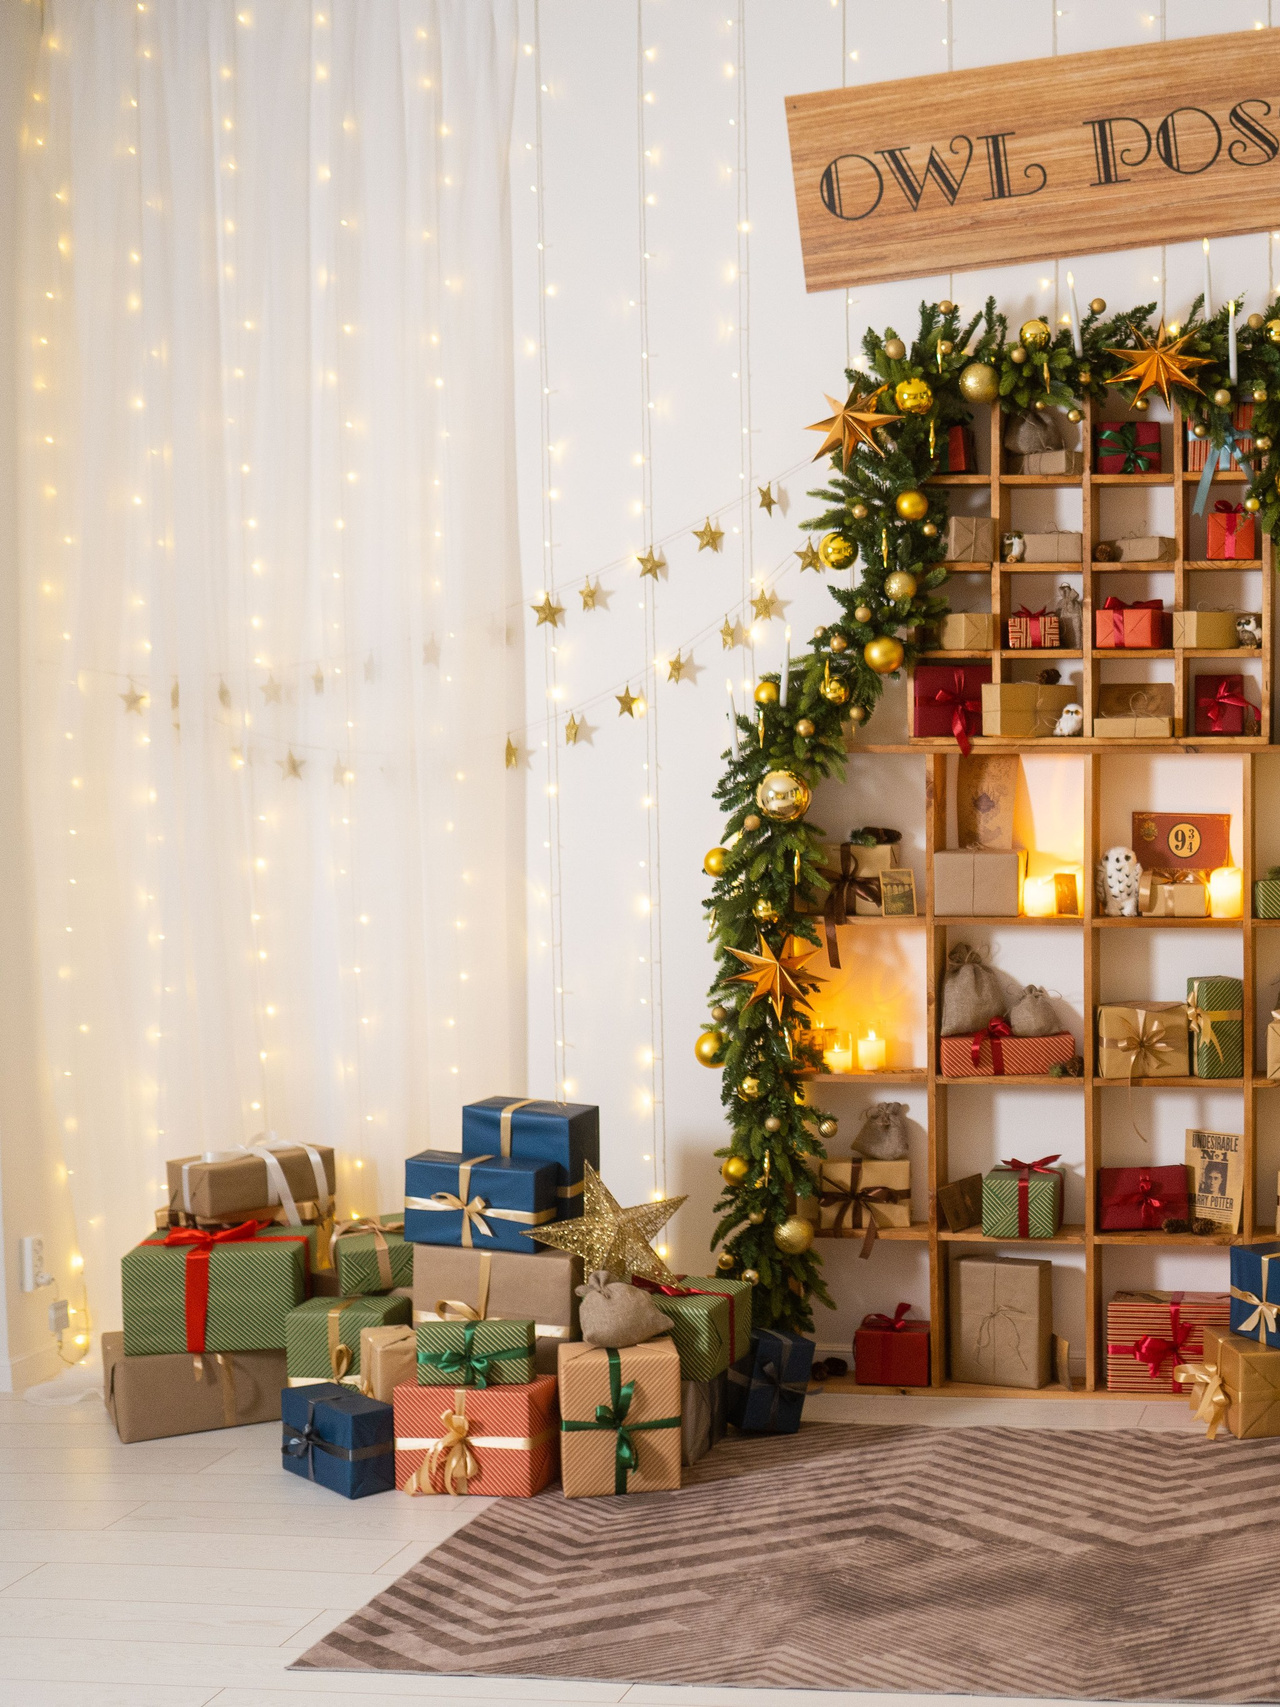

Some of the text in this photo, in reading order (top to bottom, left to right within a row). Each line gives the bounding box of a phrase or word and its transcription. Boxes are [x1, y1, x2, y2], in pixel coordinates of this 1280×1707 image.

[820, 132, 1047, 221] OWL
[1192, 1134, 1239, 1152] UNDESIRABLE
[1210, 1195, 1234, 1209] POTTER
